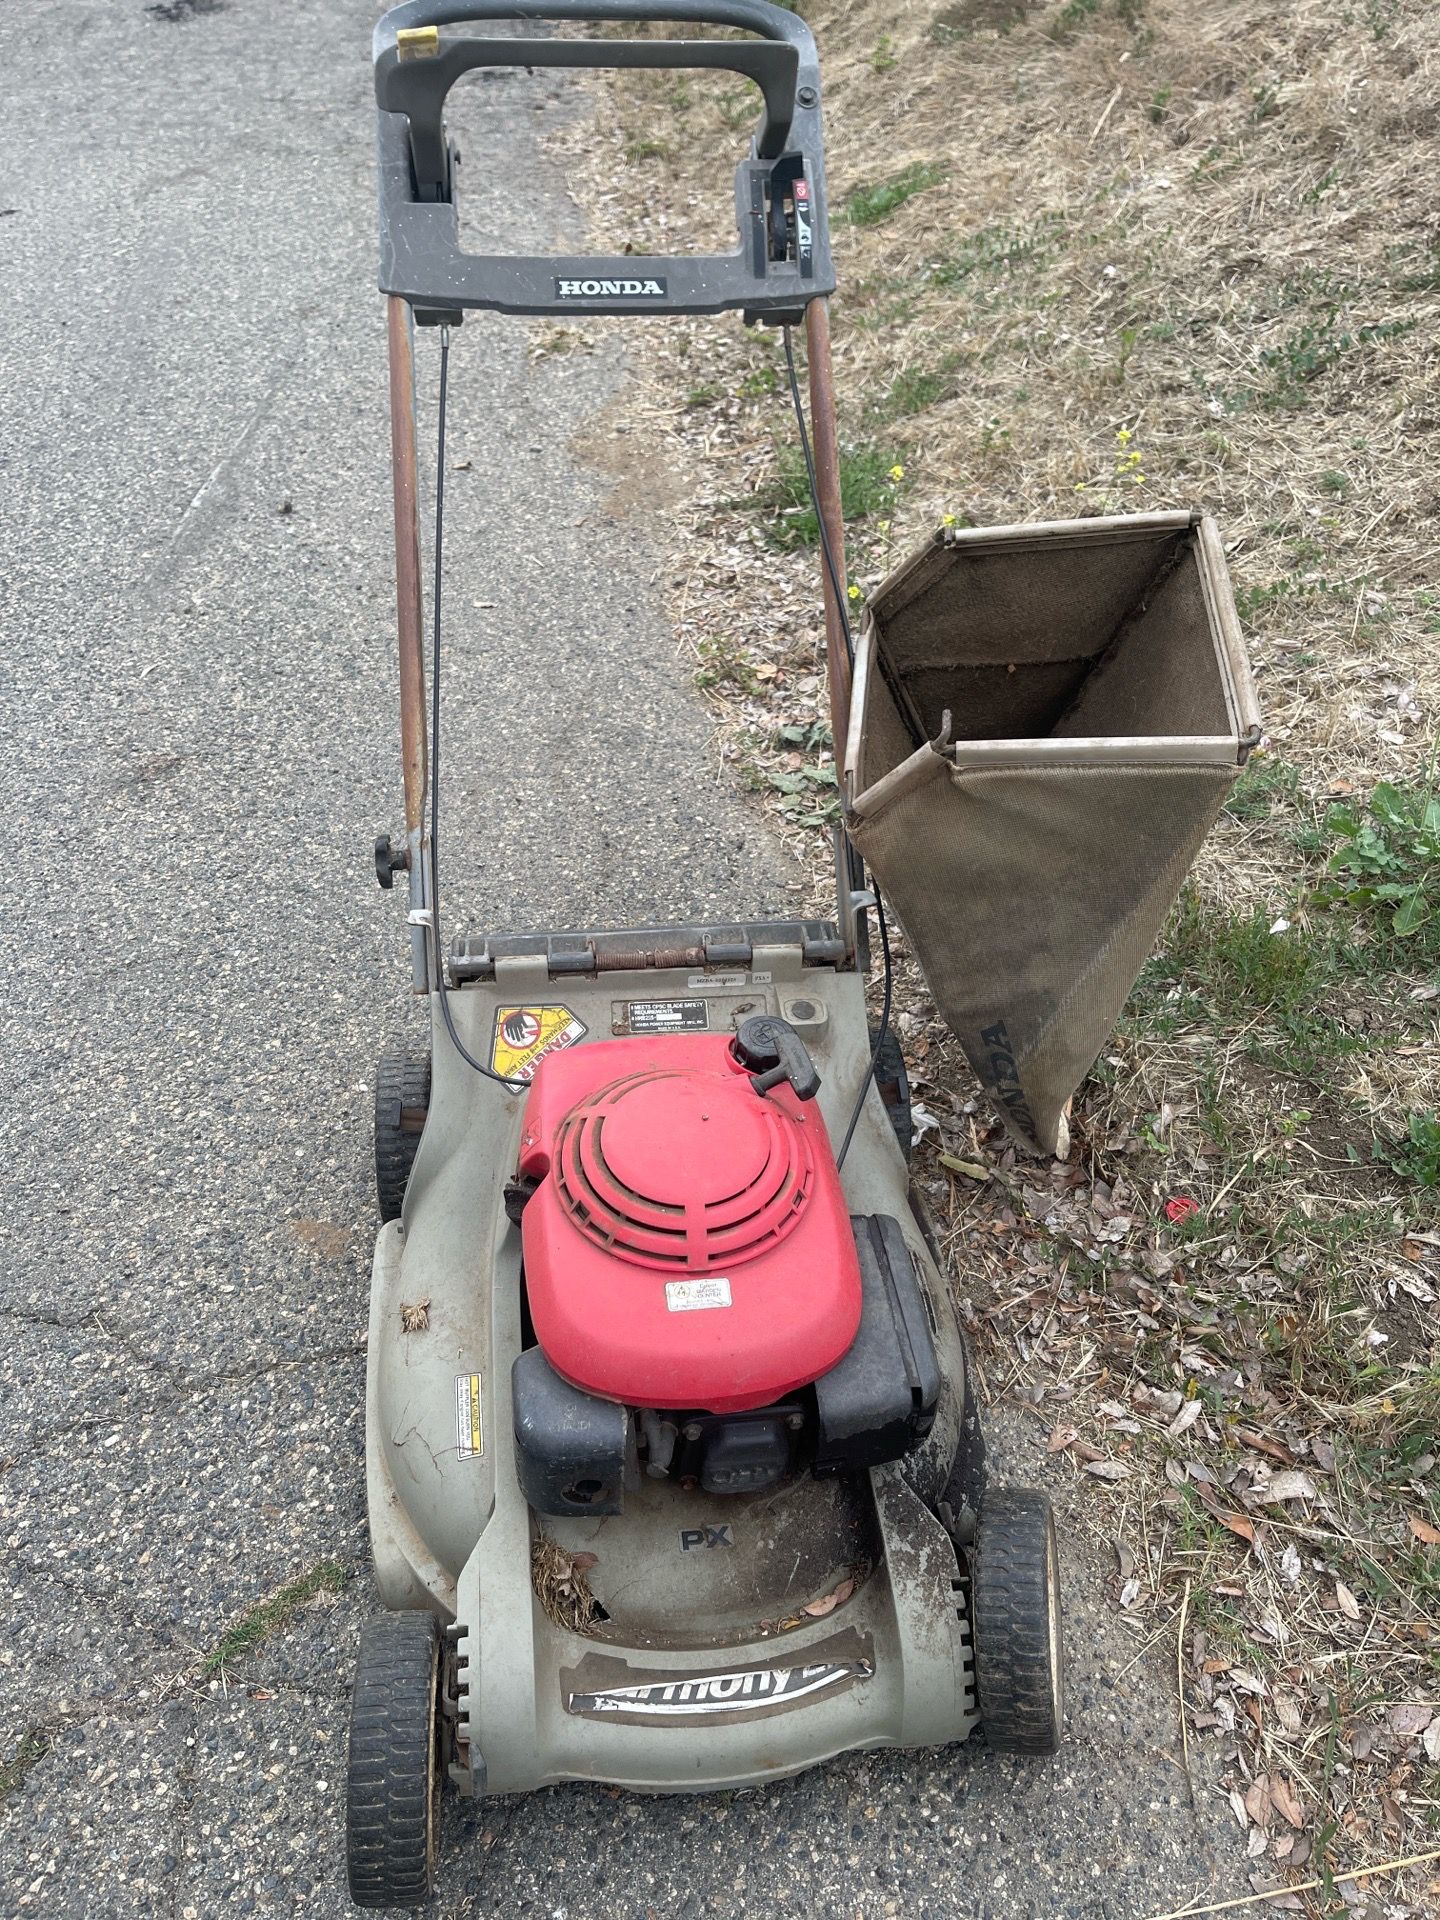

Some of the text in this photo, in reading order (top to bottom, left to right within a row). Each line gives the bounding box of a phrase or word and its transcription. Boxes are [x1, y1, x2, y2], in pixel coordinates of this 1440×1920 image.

[559, 281, 664, 295] HONDA
[557, 1016, 571, 1031] KEEP
[540, 1028, 558, 1045] HANDS
[517, 1052, 531, 1064] FEET
[518, 1031, 572, 1080] DANGER
[681, 1526, 733, 1550] PX
